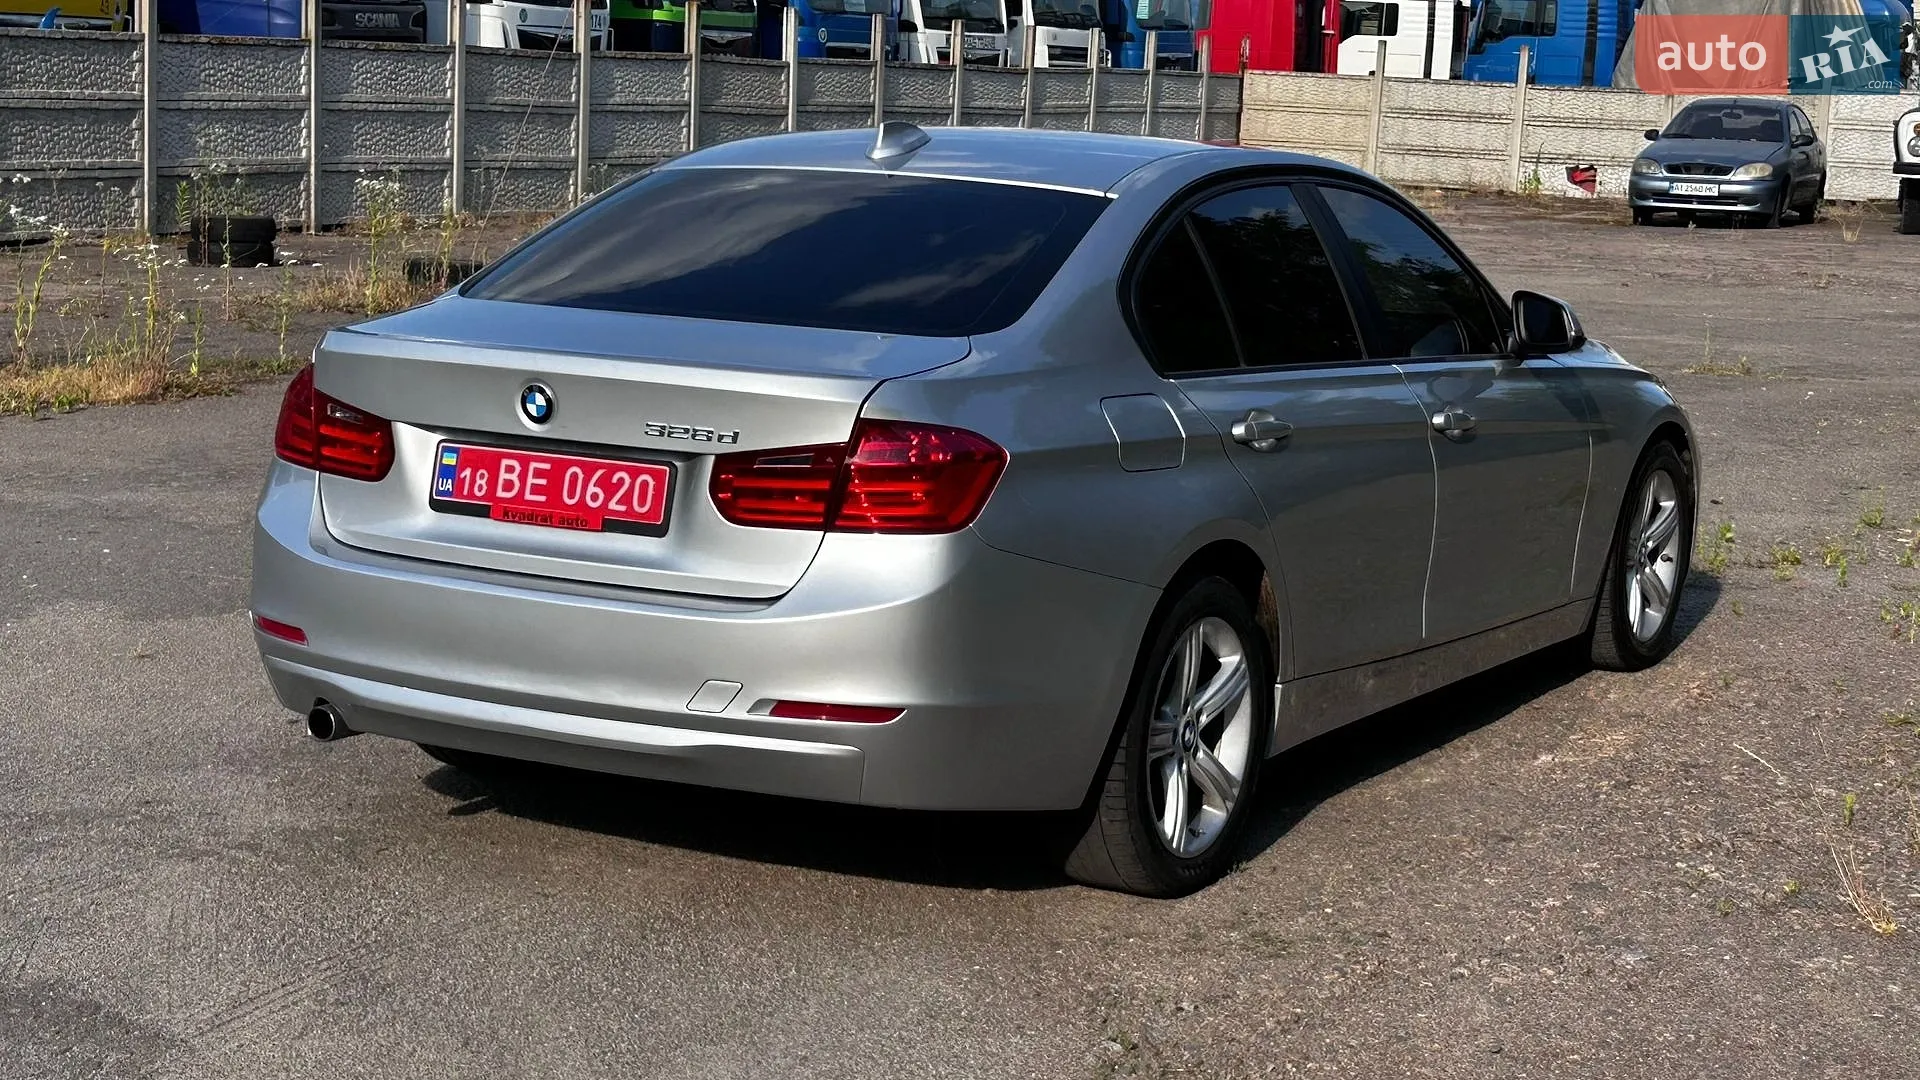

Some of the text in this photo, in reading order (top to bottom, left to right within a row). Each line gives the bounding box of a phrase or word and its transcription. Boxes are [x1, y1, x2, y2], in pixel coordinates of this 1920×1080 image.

[355, 12, 400, 28] SCANIA
[438, 458, 656, 514] UA 18 BE 0620
[559, 514, 589, 528] auto
